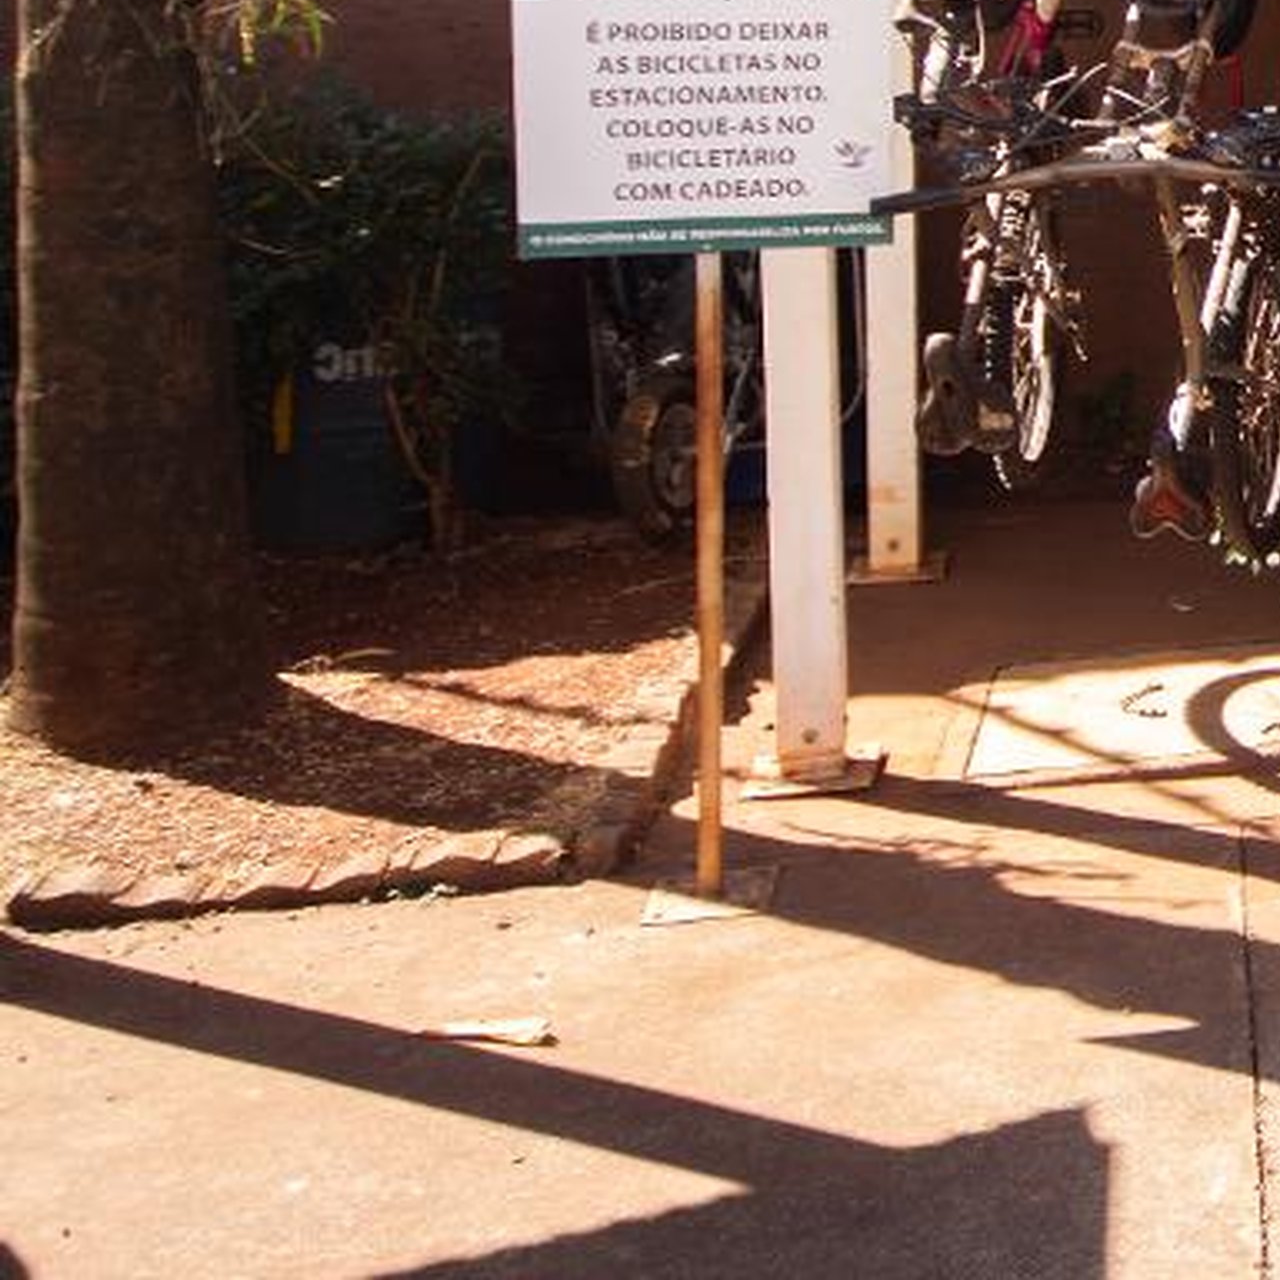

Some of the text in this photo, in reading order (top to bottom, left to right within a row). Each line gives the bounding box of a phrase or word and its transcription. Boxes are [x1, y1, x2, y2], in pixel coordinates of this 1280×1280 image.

[585, 21, 829, 44] É PROIBIDO DEIXAR
[598, 53, 822, 75] AS BICICLETAS NO
[589, 85, 829, 108] ESTACIONAMENTO.
[605, 115, 815, 139] COLOQUE-AS NO
[613, 179, 809, 202] COM CADEADO.
